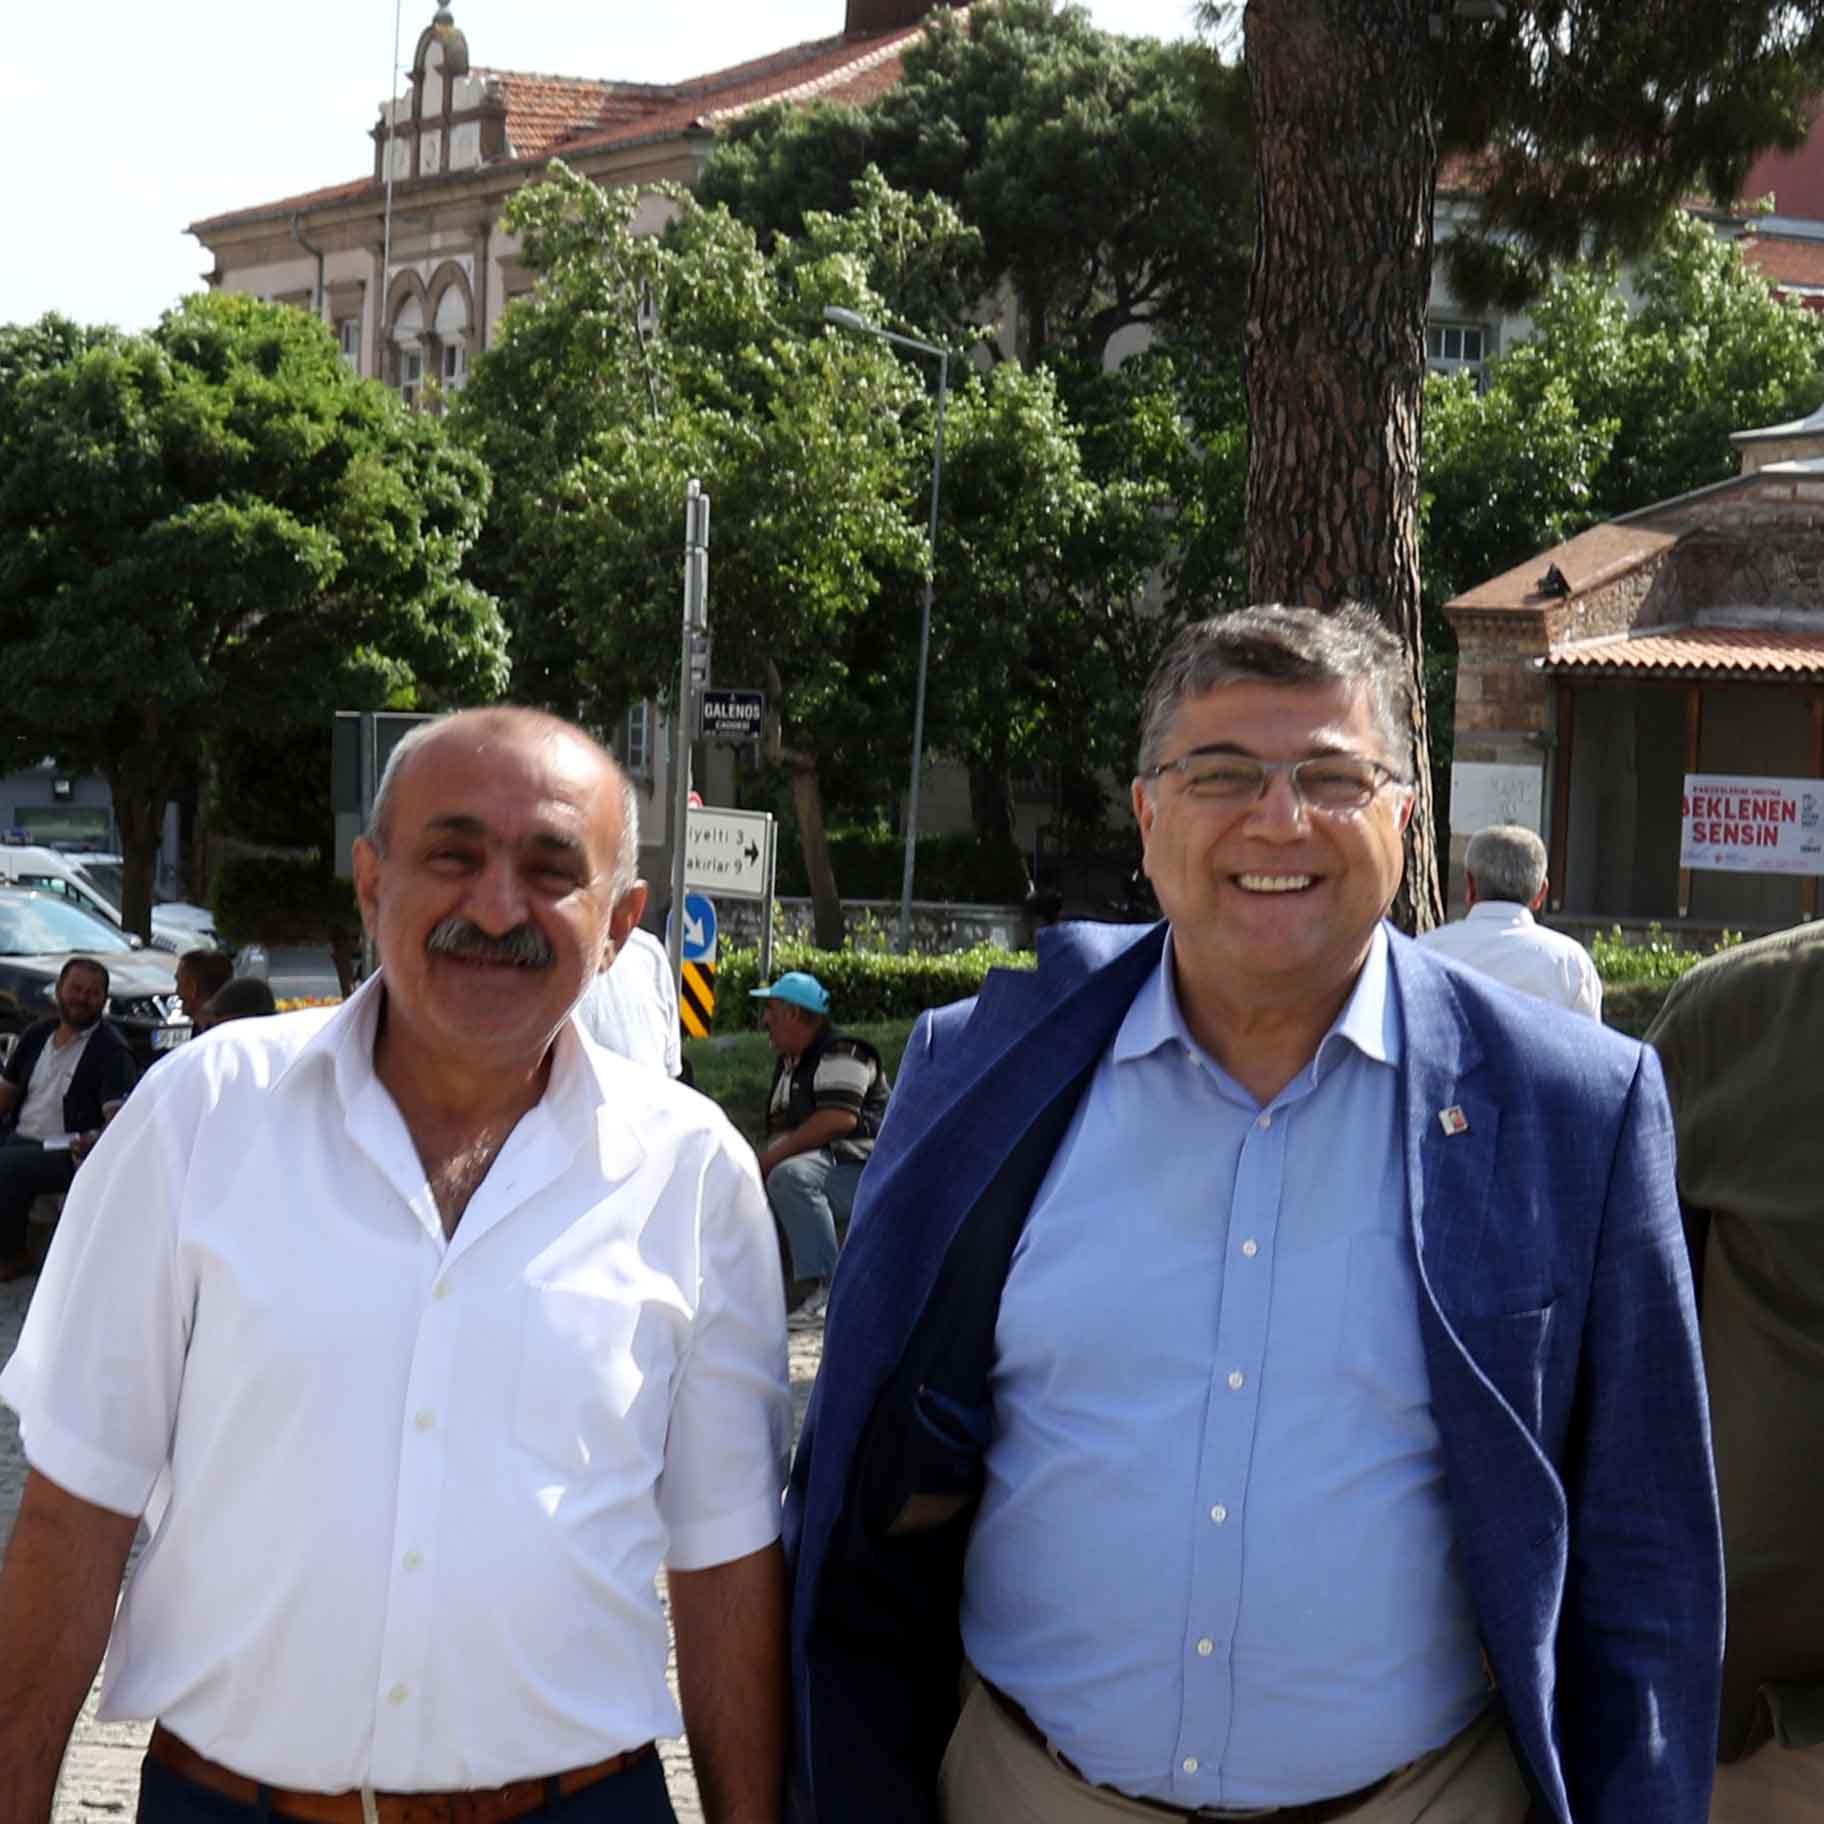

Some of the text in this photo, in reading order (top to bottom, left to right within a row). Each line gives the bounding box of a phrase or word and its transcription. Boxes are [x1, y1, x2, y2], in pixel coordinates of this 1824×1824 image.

[704, 702, 760, 720] GALENOS
[689, 826, 744, 846] iyelti 3
[1693, 821, 1778, 847] SENSİN
[687, 856, 730, 874] akırlar
